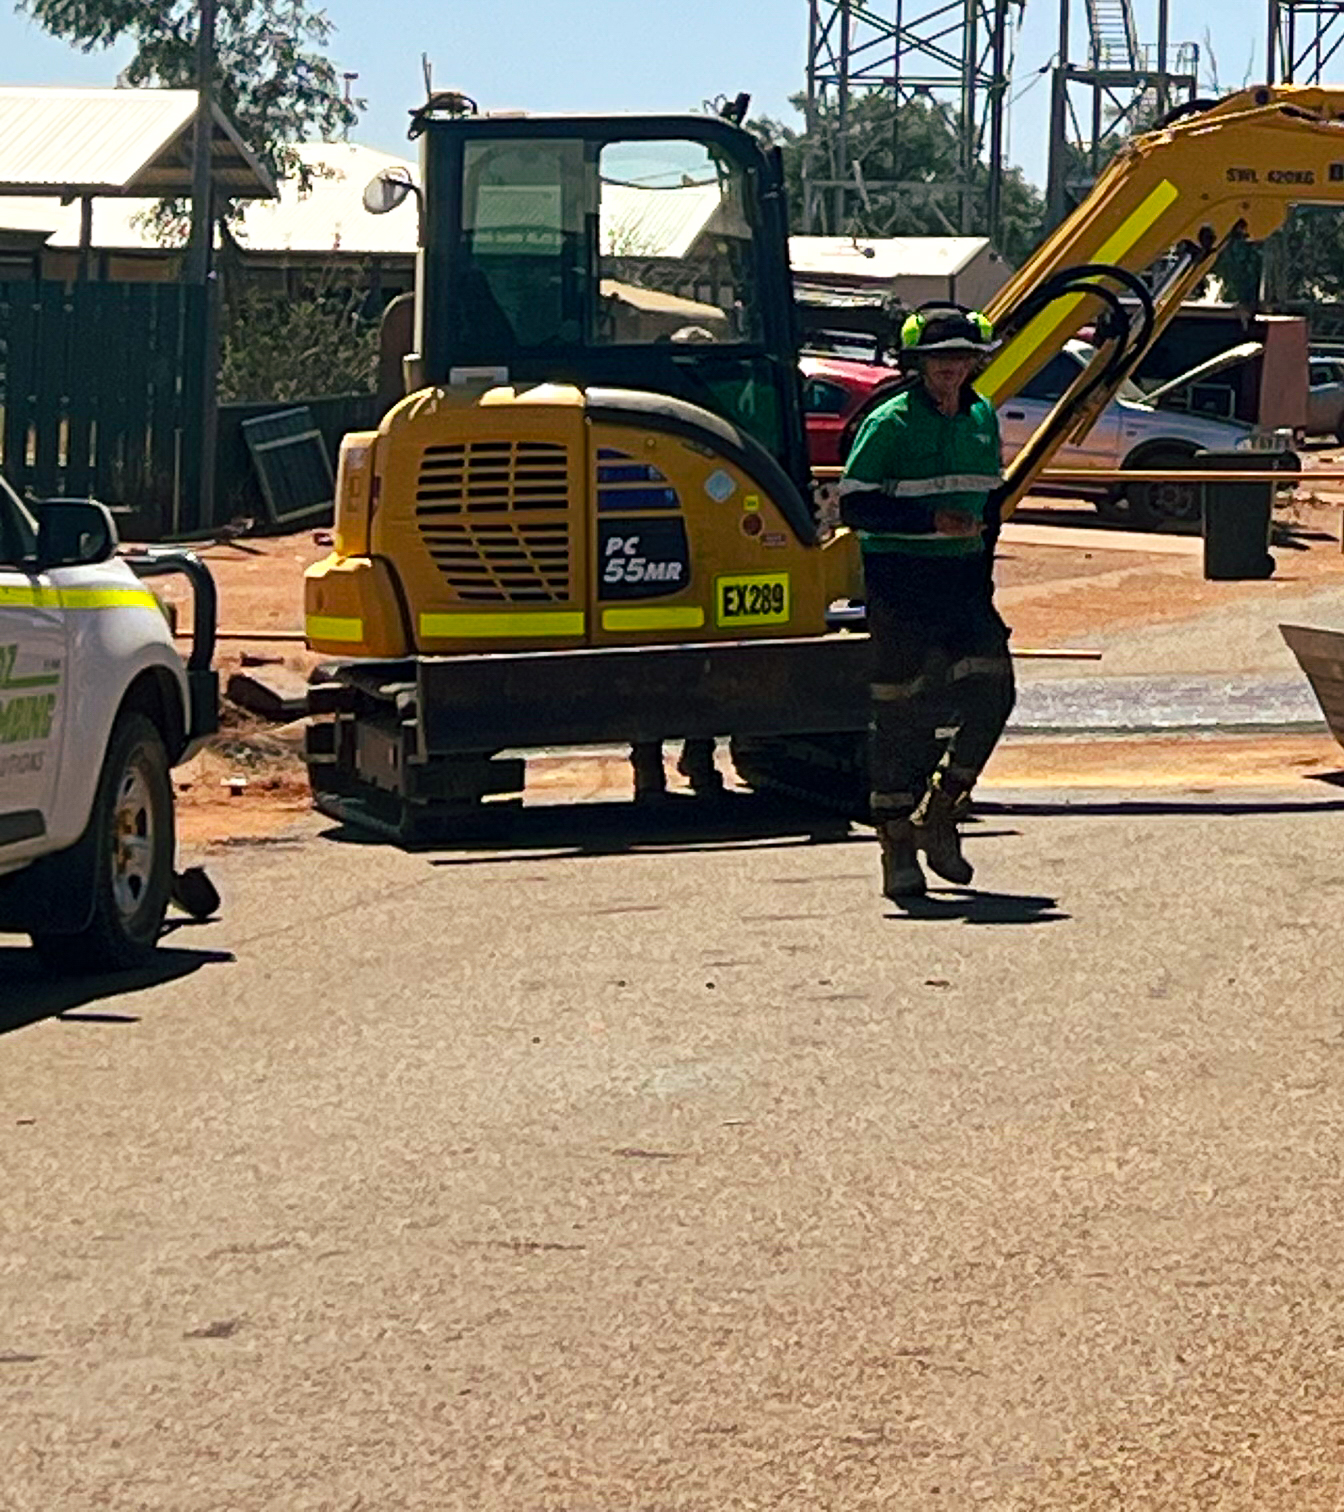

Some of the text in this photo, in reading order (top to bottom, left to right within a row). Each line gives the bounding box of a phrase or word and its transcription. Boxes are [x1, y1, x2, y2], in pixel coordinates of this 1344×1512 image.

[605, 536, 640, 556] PC
[603, 558, 682, 583] 55MR
[723, 583, 785, 617] EX289
